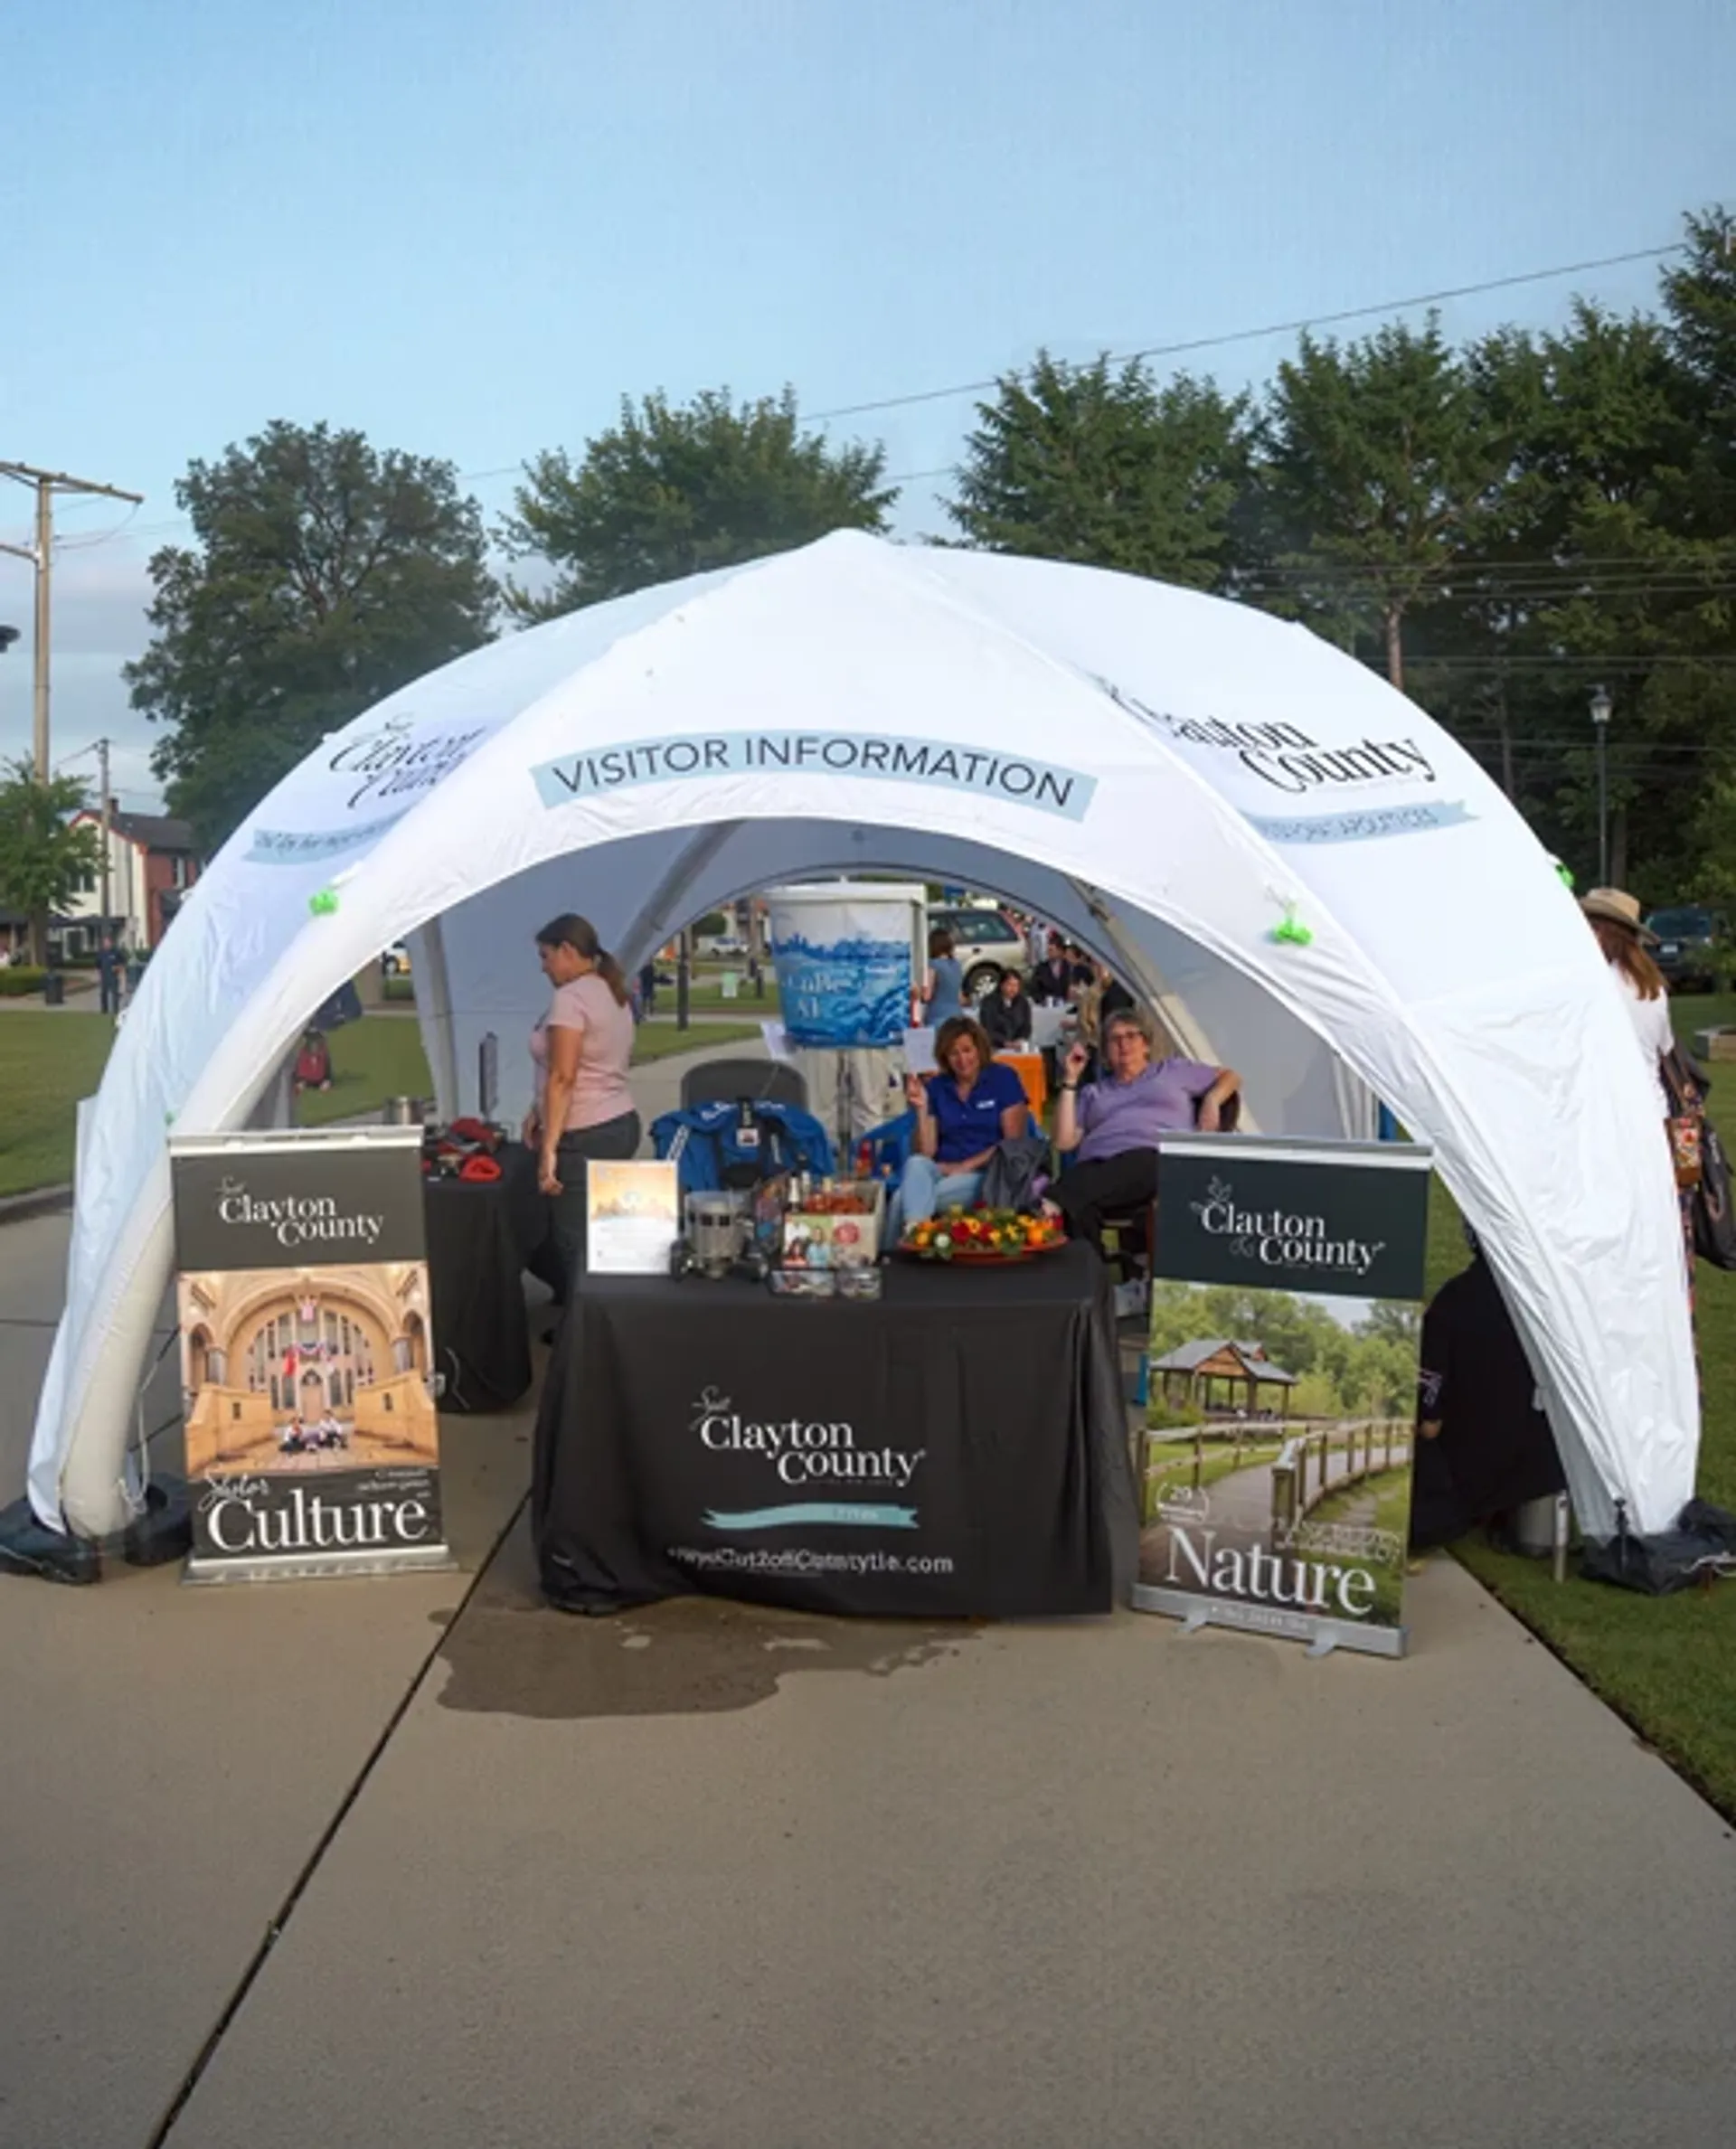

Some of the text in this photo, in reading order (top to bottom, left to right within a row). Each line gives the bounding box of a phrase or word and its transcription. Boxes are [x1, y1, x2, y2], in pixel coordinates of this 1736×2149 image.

[552, 739, 730, 794] VISITOR
[745, 737, 1074, 806] INFORMATION
[1239, 738, 1436, 793] County
[219, 1194, 336, 1224] Clayton
[270, 1213, 383, 1246] County
[1259, 1235, 1387, 1275] County
[700, 1414, 854, 1459] Clayton
[777, 1447, 926, 1487] County
[208, 1486, 429, 1552] Culture
[1165, 1526, 1376, 1615] Nature
